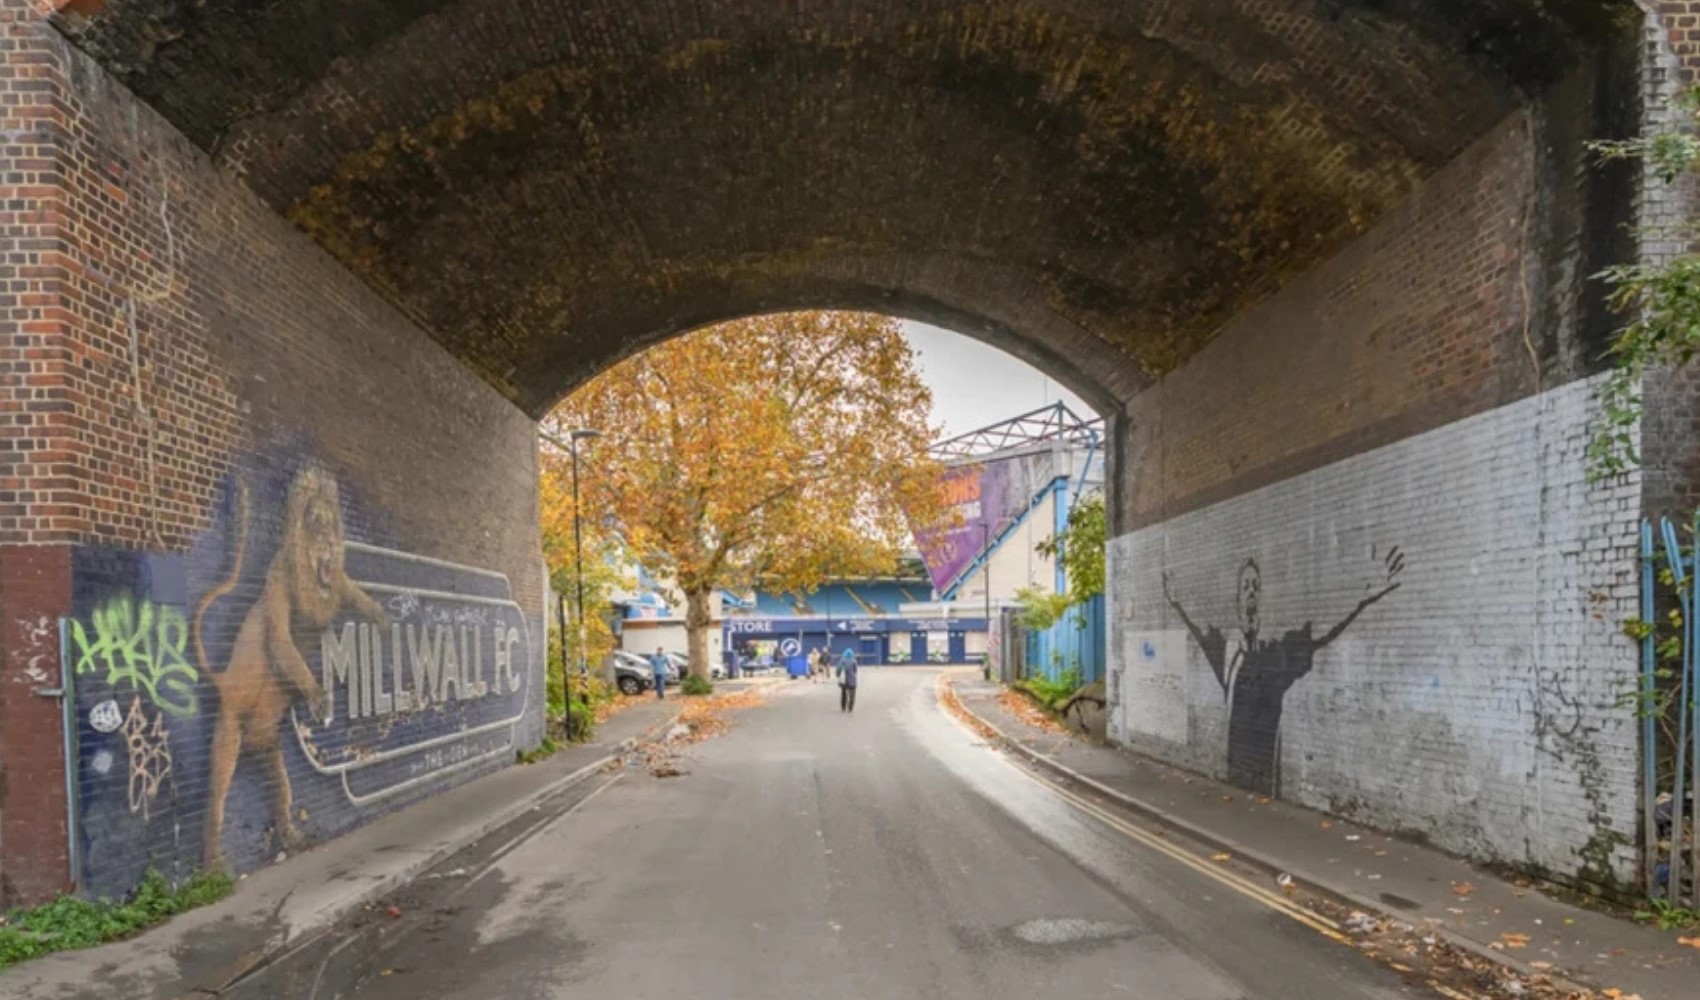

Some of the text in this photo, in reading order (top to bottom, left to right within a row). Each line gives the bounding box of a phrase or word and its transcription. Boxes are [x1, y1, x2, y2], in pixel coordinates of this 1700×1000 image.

[730, 620, 772, 633] STORE
[321, 621, 521, 728] MILLWALL FC
